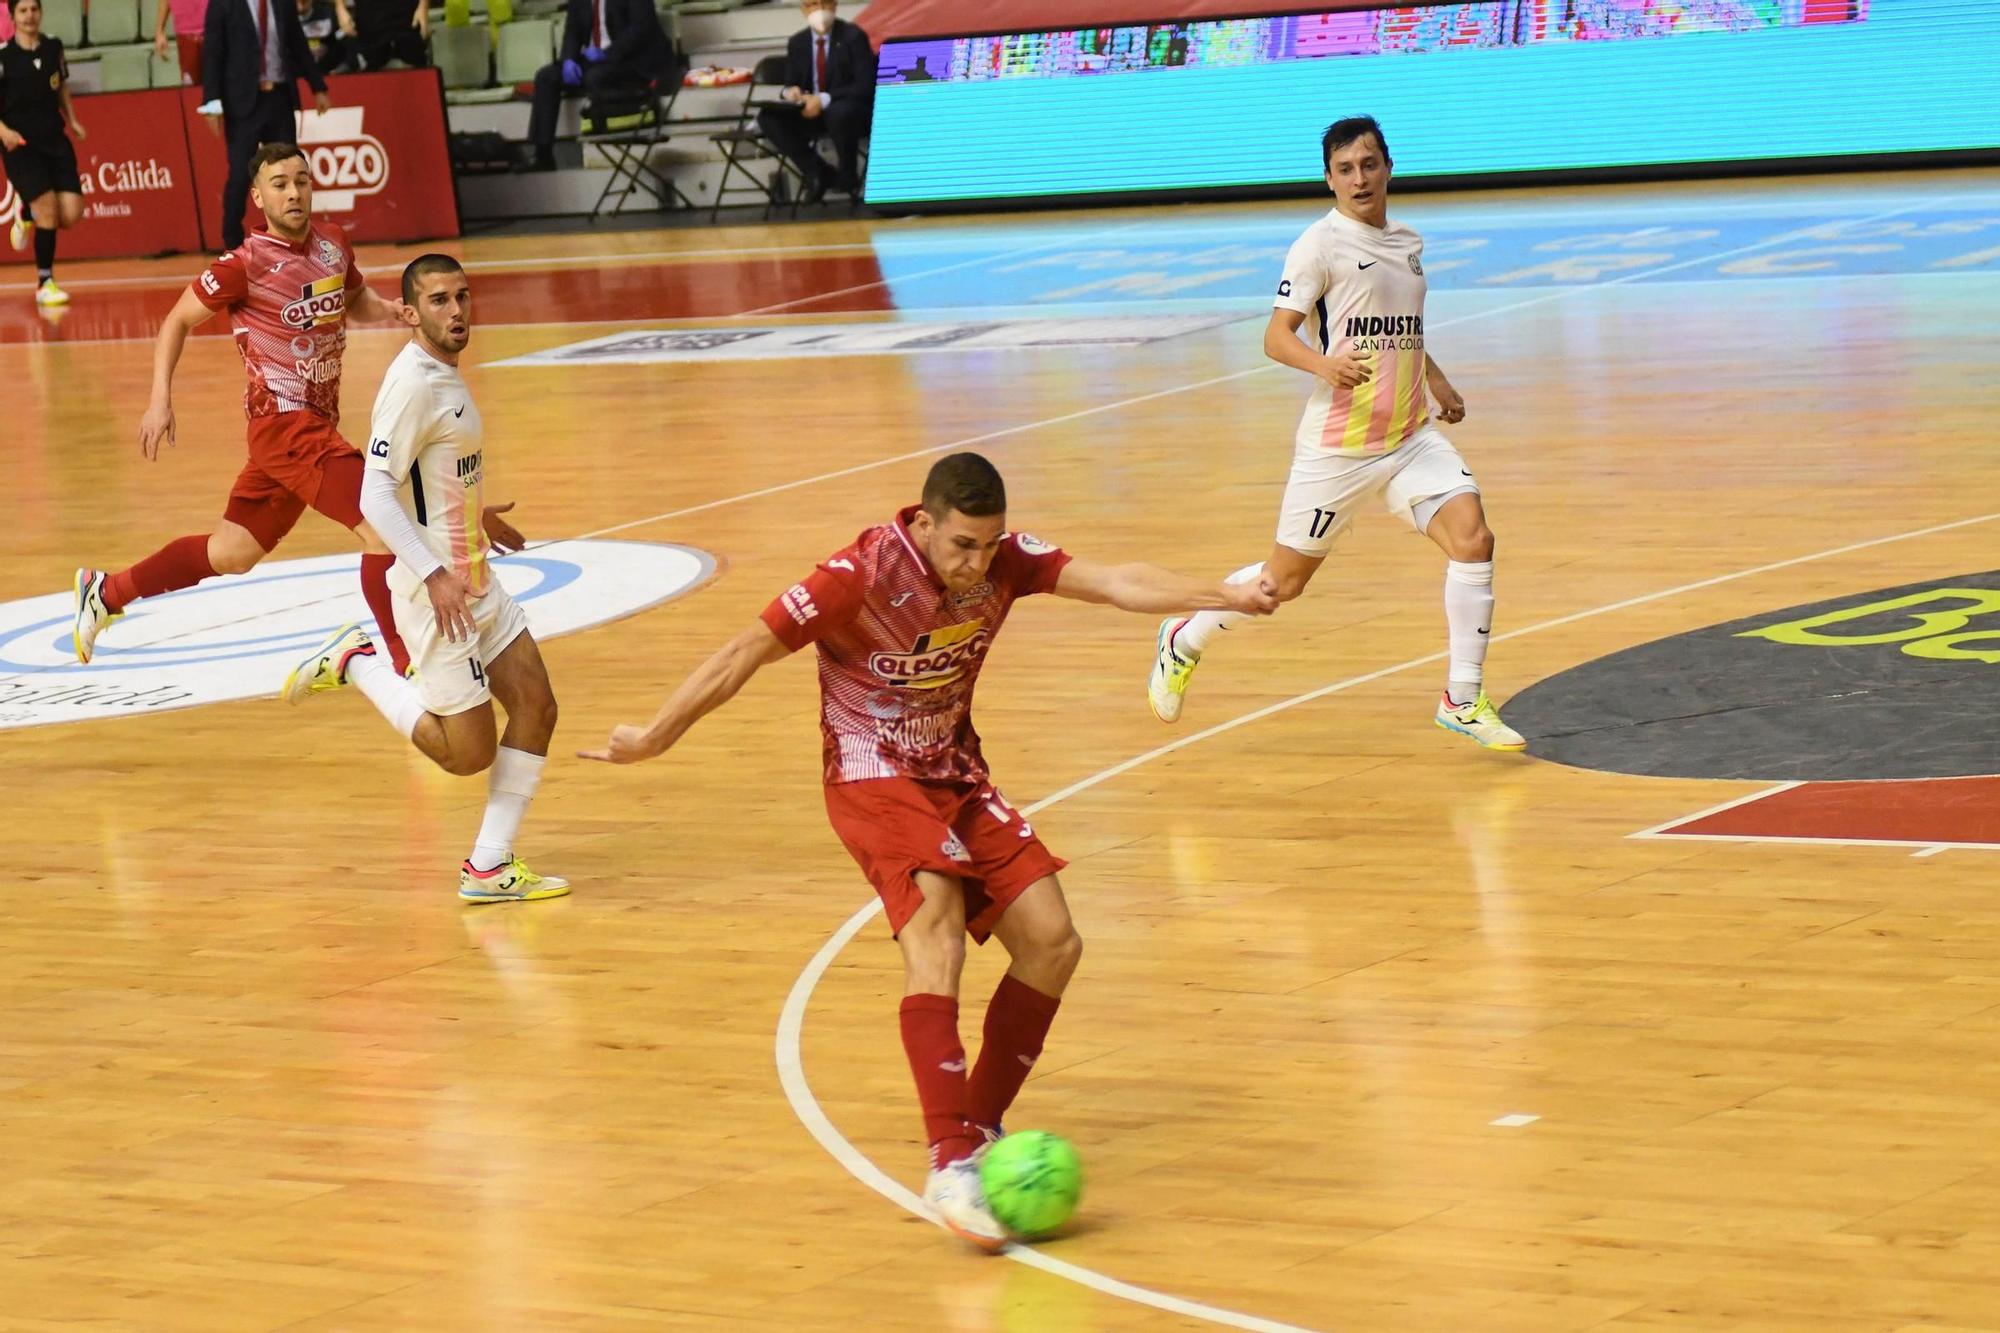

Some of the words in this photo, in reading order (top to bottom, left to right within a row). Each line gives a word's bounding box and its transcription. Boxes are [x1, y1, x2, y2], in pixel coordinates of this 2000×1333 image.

[98, 159, 173, 193] Cálida
[92, 202, 132, 217] Murcia
[1353, 339, 1396, 351] SANTA
[1309, 508, 1336, 539] 17
[468, 657, 486, 688] 4
